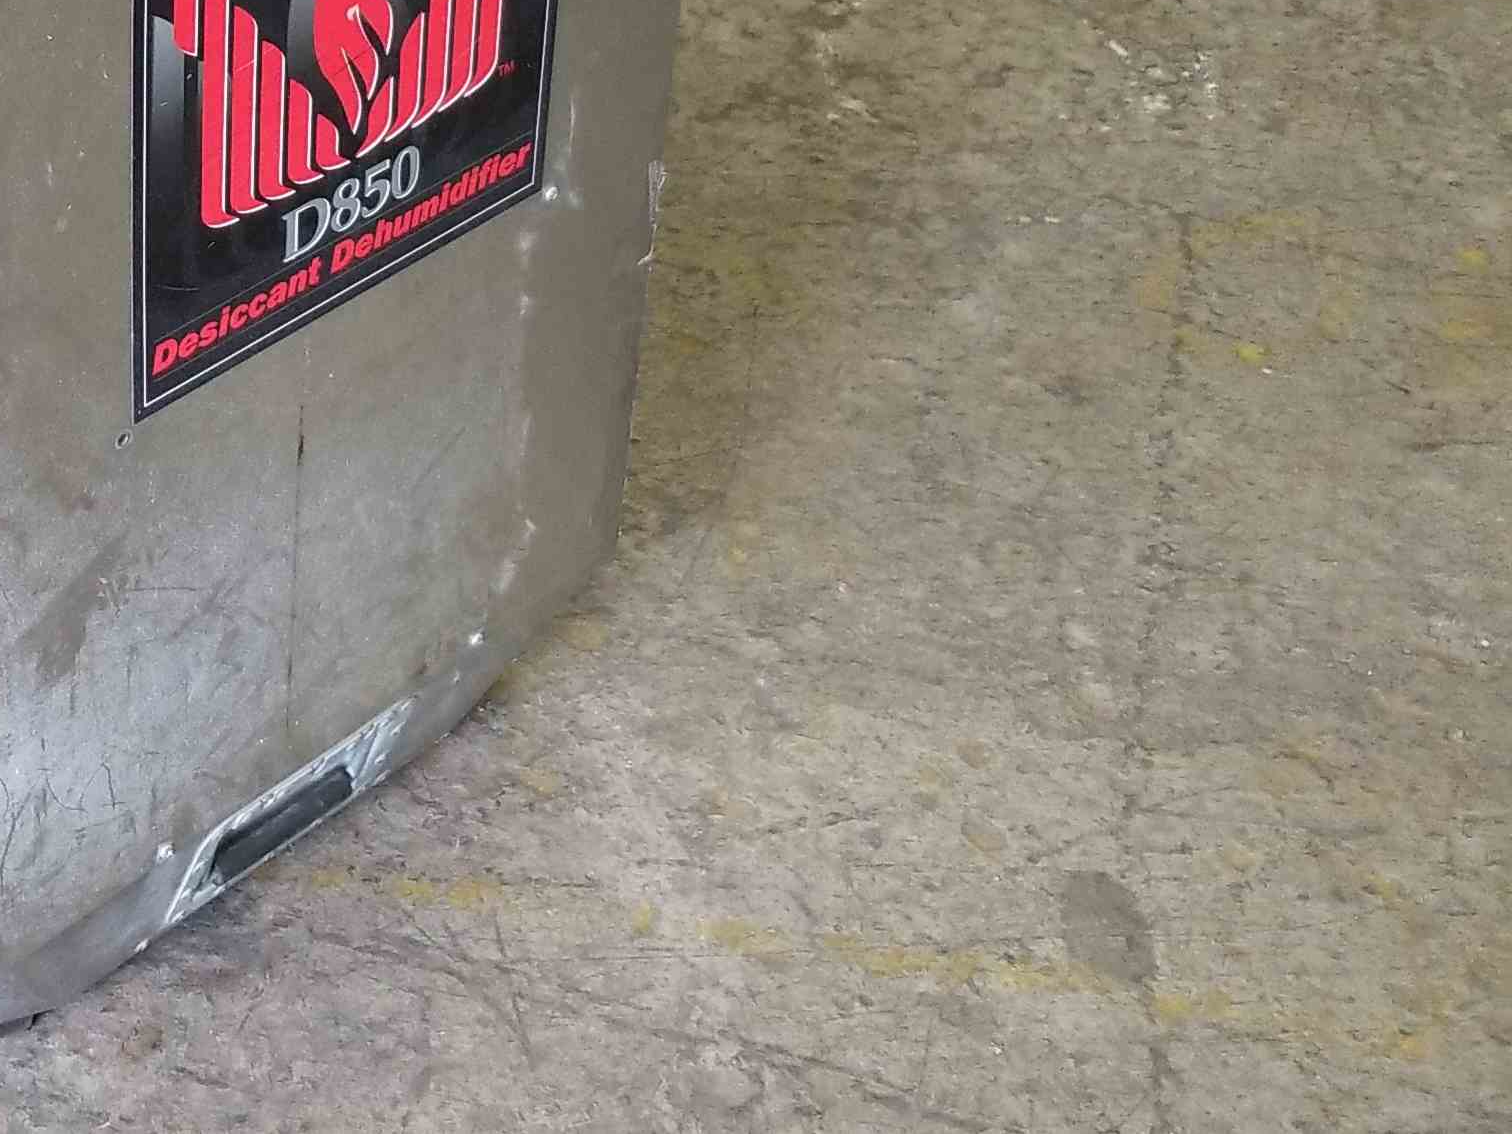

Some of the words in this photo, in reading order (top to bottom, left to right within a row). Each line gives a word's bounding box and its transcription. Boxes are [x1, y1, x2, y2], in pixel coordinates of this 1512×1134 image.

[152, 257, 322, 378] Desiccant
[330, 140, 532, 278] Dehumidifier
[281, 145, 421, 264] D850
